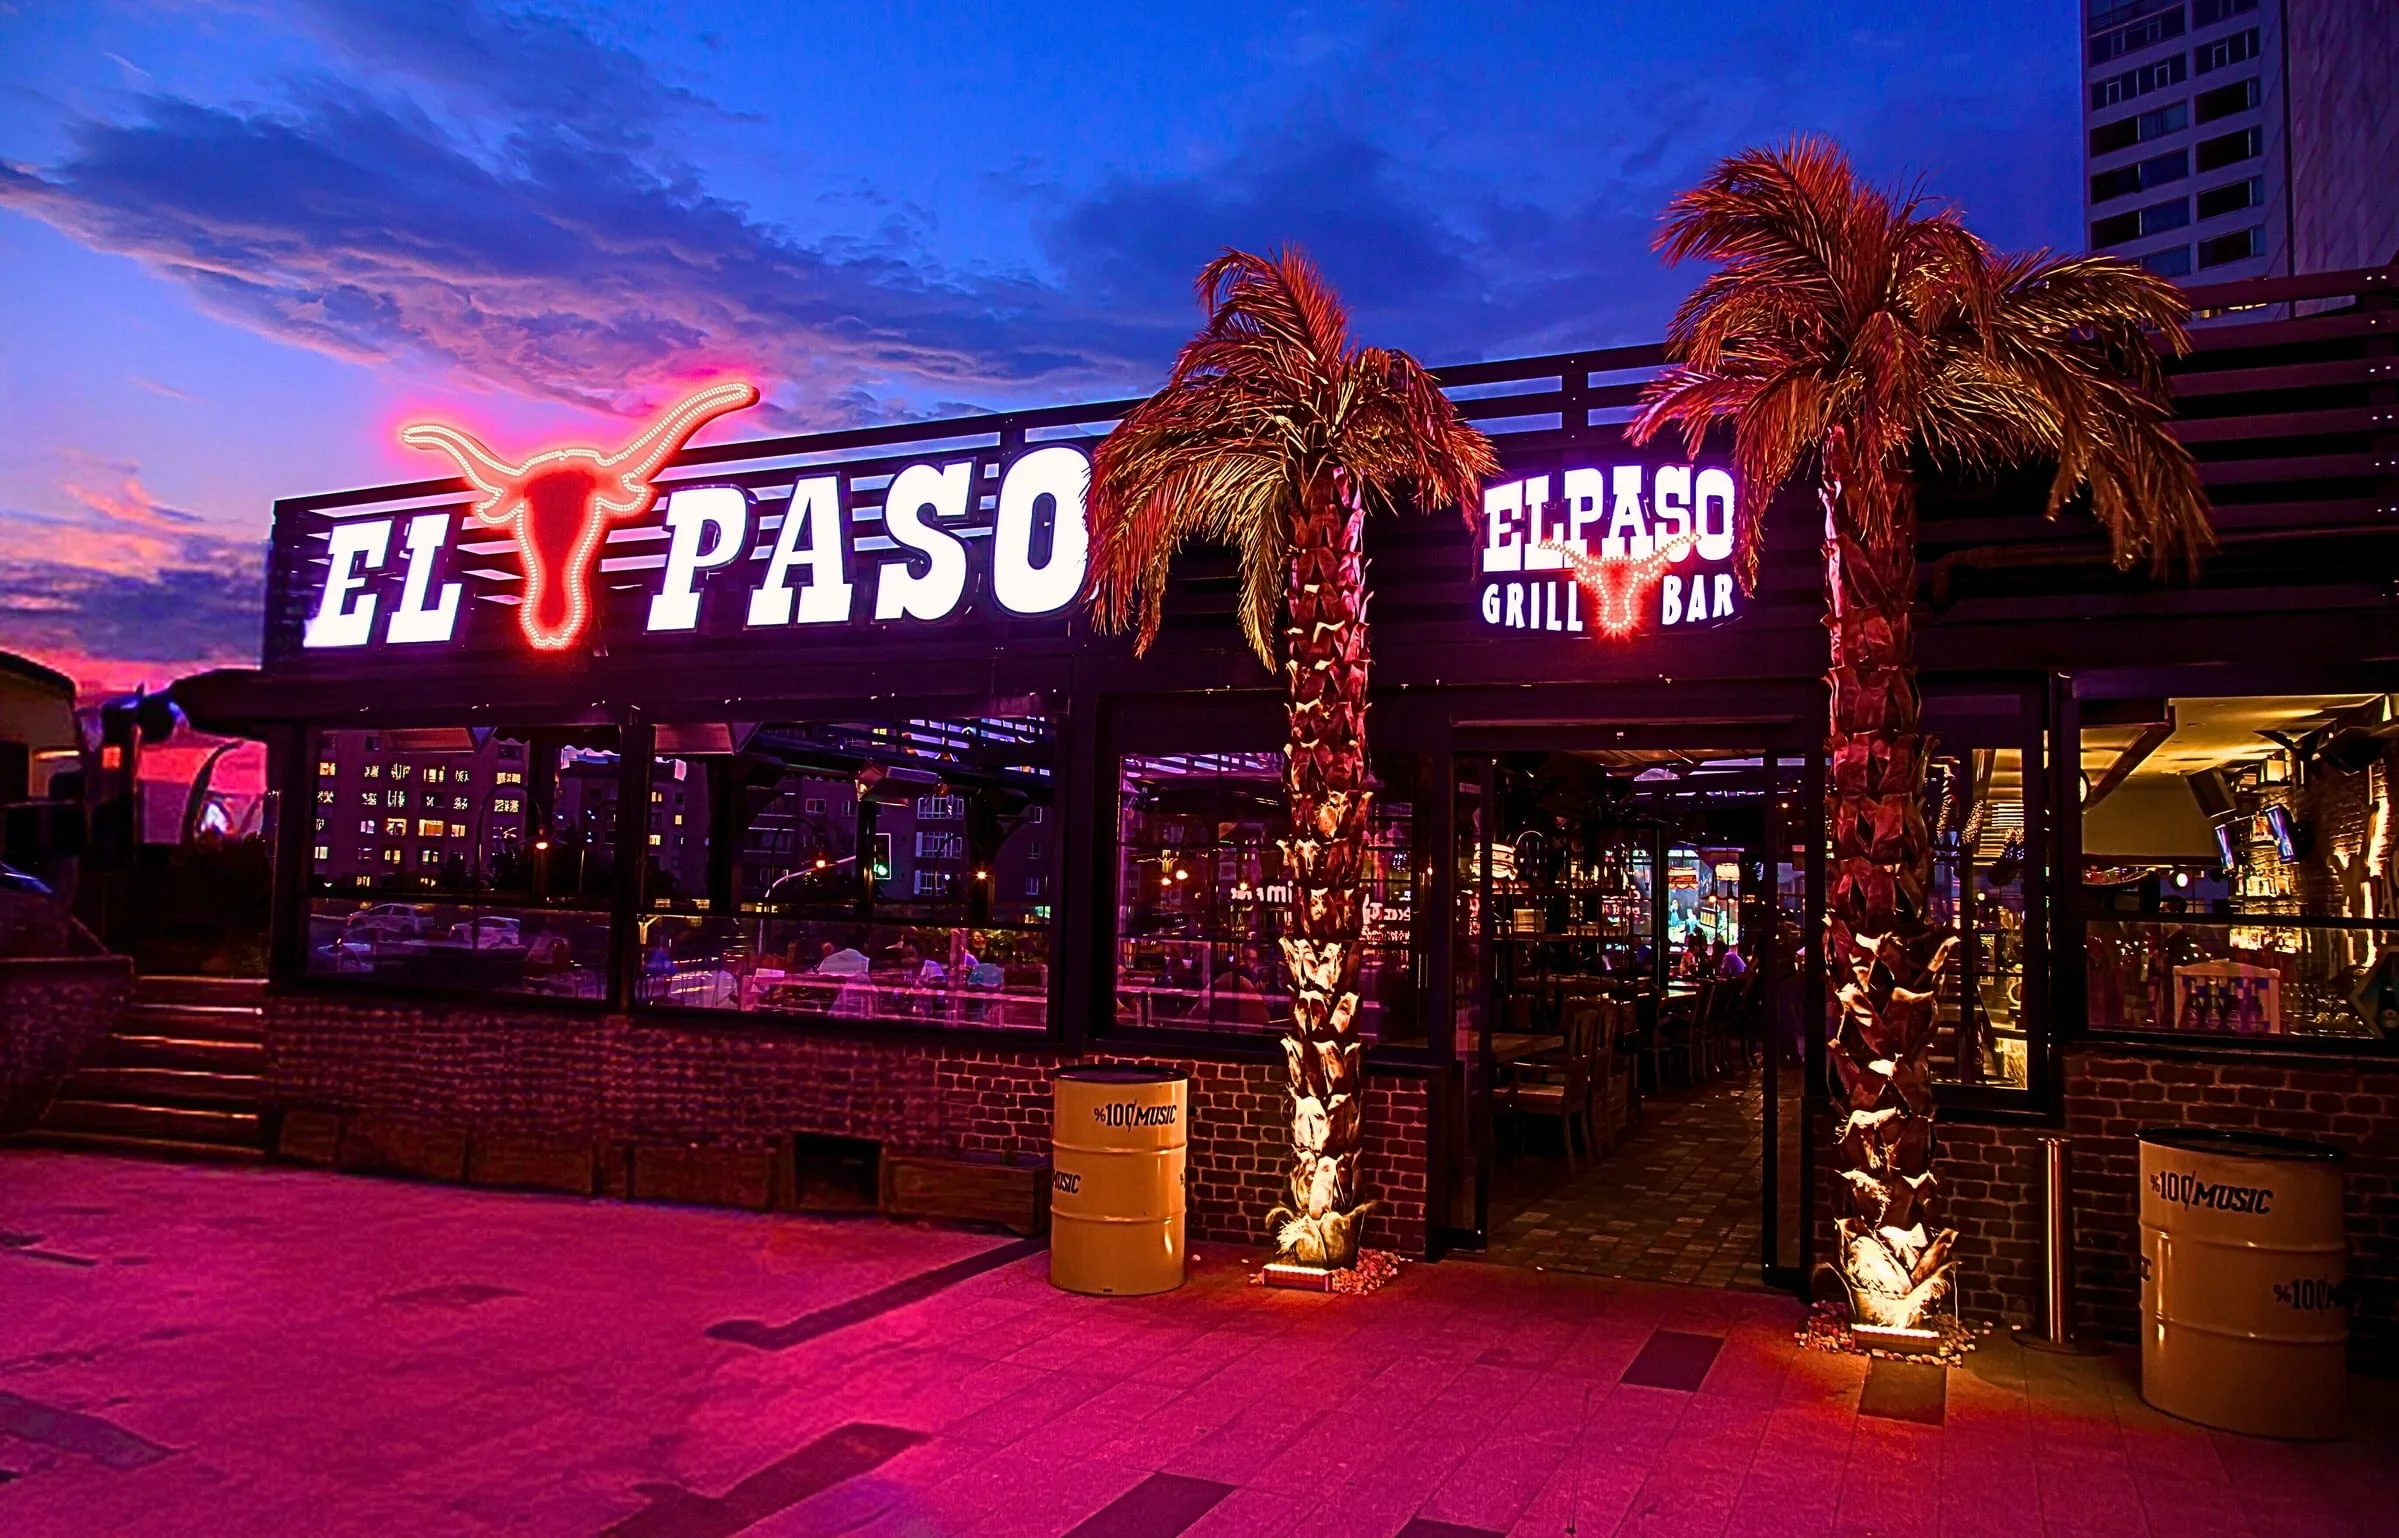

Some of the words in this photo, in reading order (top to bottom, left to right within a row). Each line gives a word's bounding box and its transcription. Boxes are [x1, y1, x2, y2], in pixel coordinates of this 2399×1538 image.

[304, 514, 463, 648] EL
[647, 447, 1091, 631] PASO
[1482, 581, 1583, 631] GRILL
[1662, 574, 1735, 625] BAR
